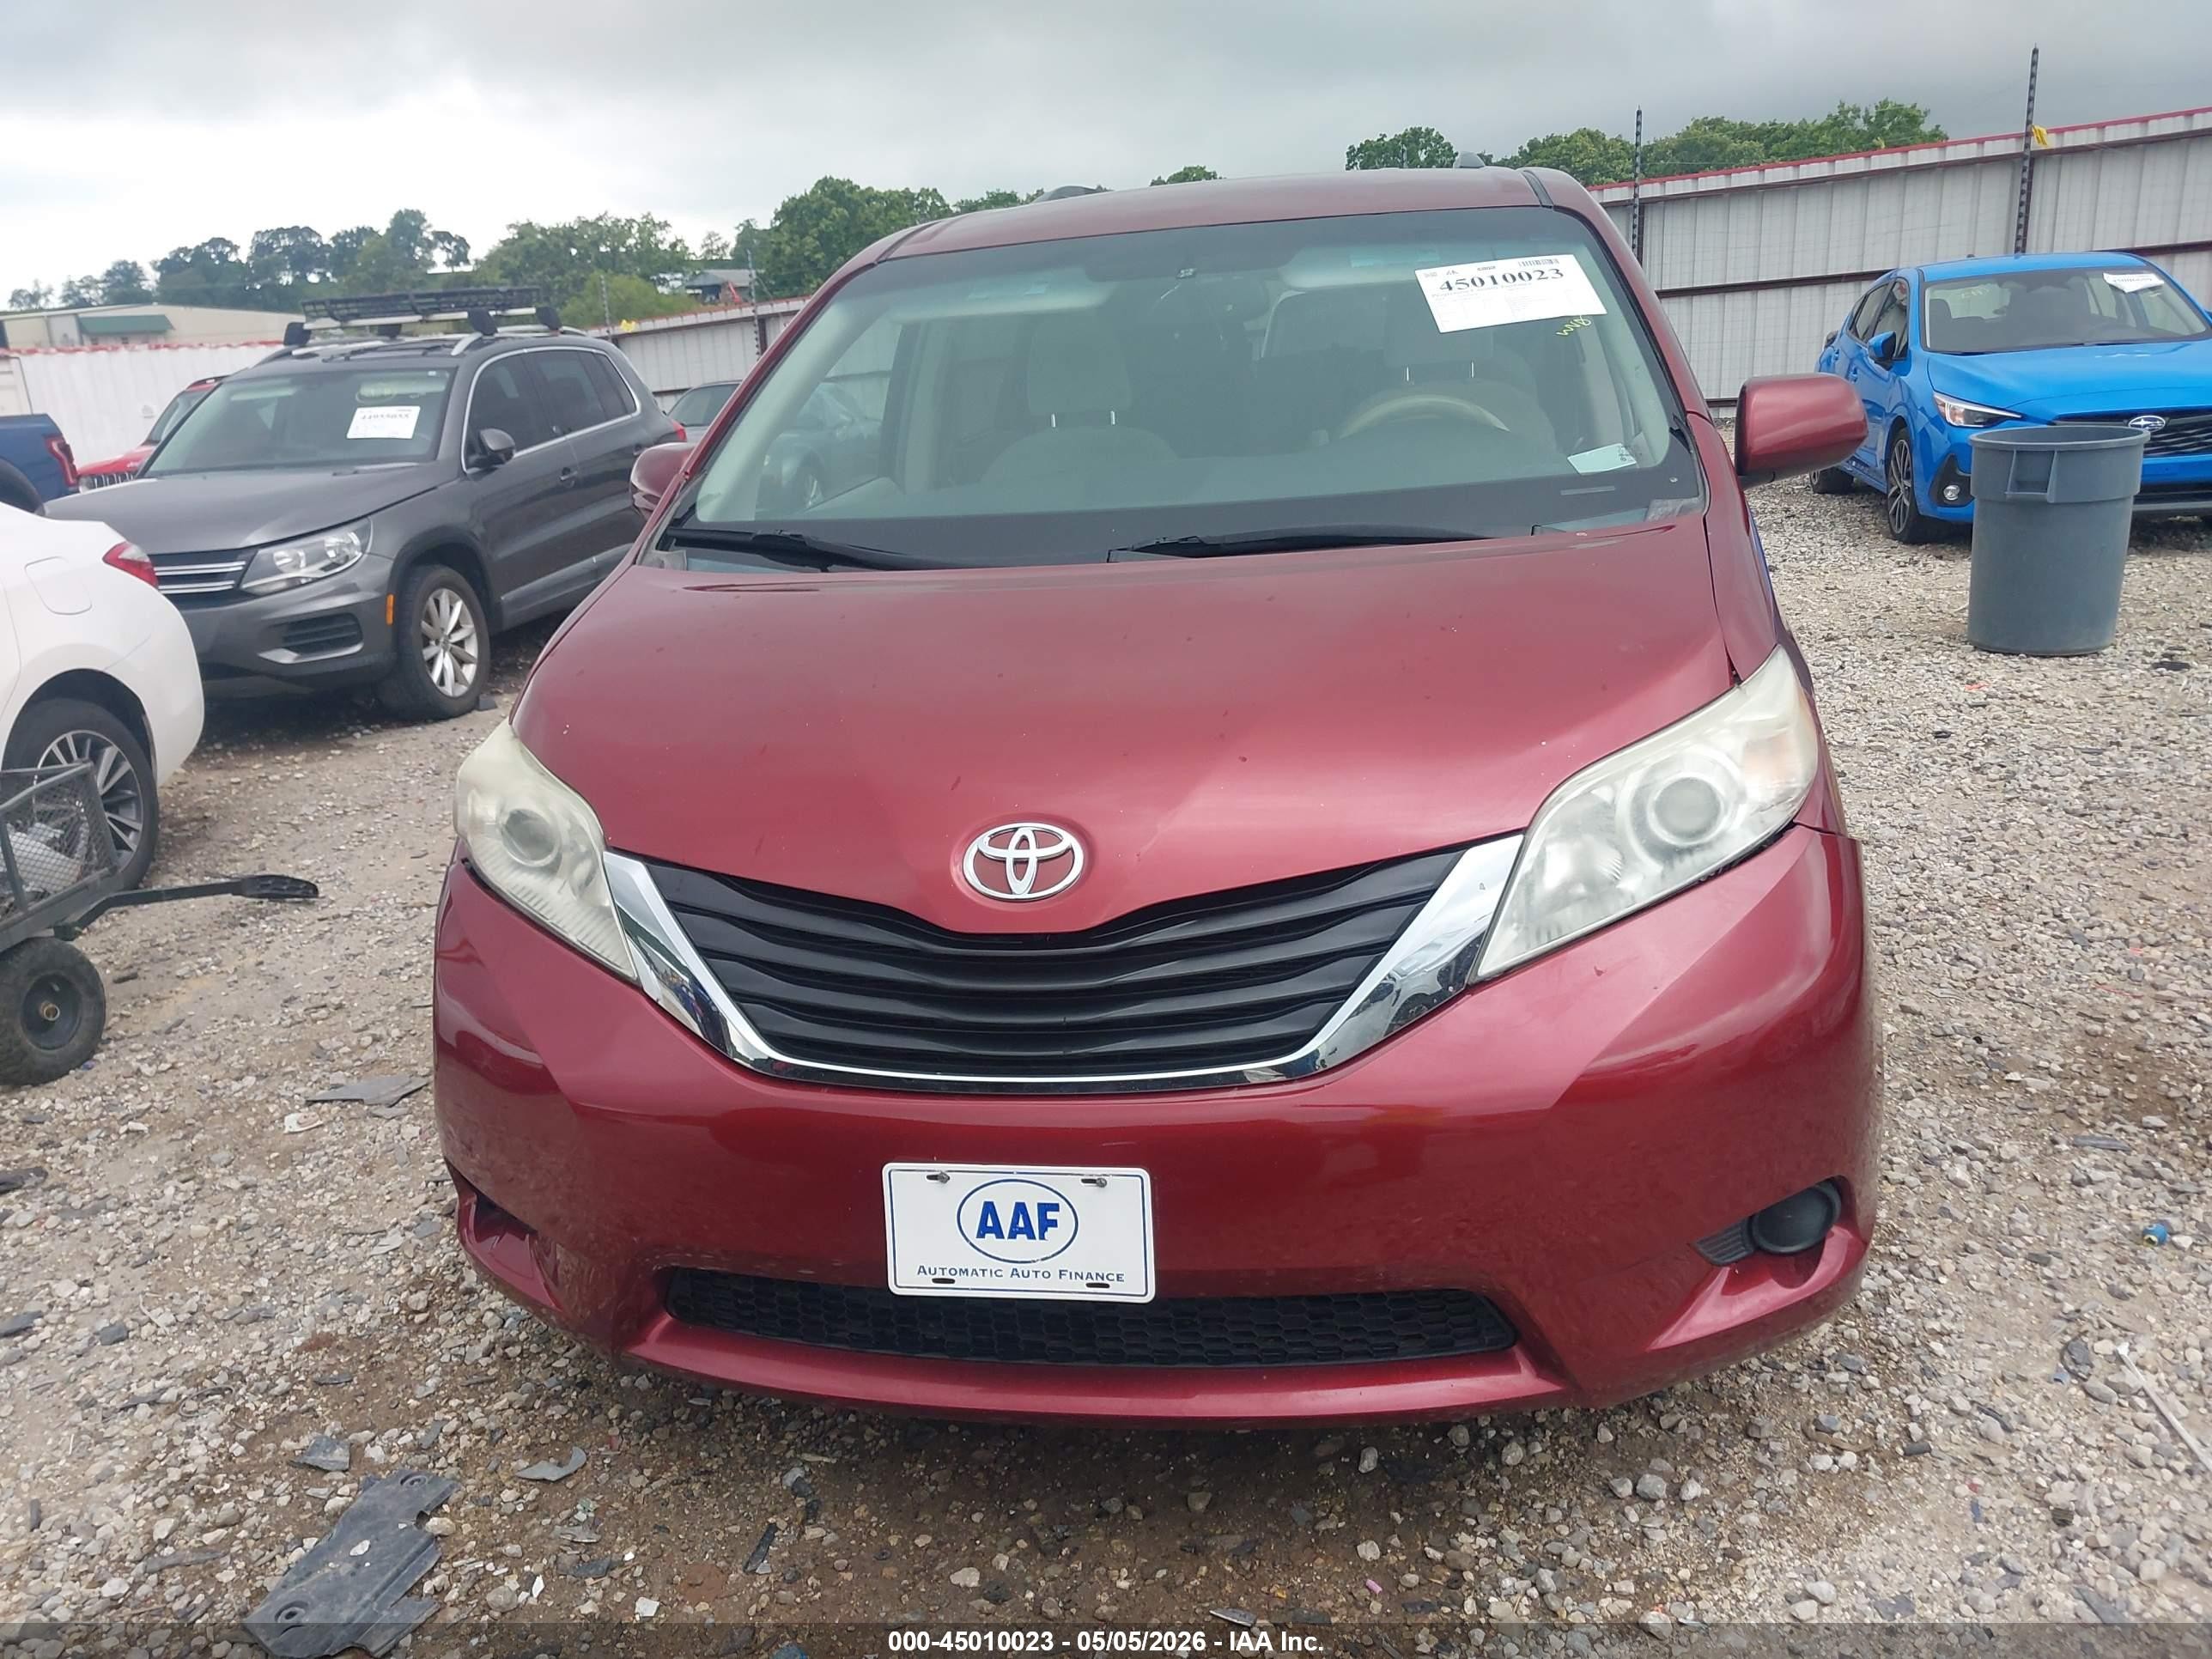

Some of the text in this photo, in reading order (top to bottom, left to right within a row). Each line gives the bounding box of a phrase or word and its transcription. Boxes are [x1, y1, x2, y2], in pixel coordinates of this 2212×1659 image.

[1439, 268, 1565, 291] 45010023
[975, 1200, 1060, 1241] AAF
[916, 1264, 1125, 1282] AUTOMATIC AUTO FINANCE
